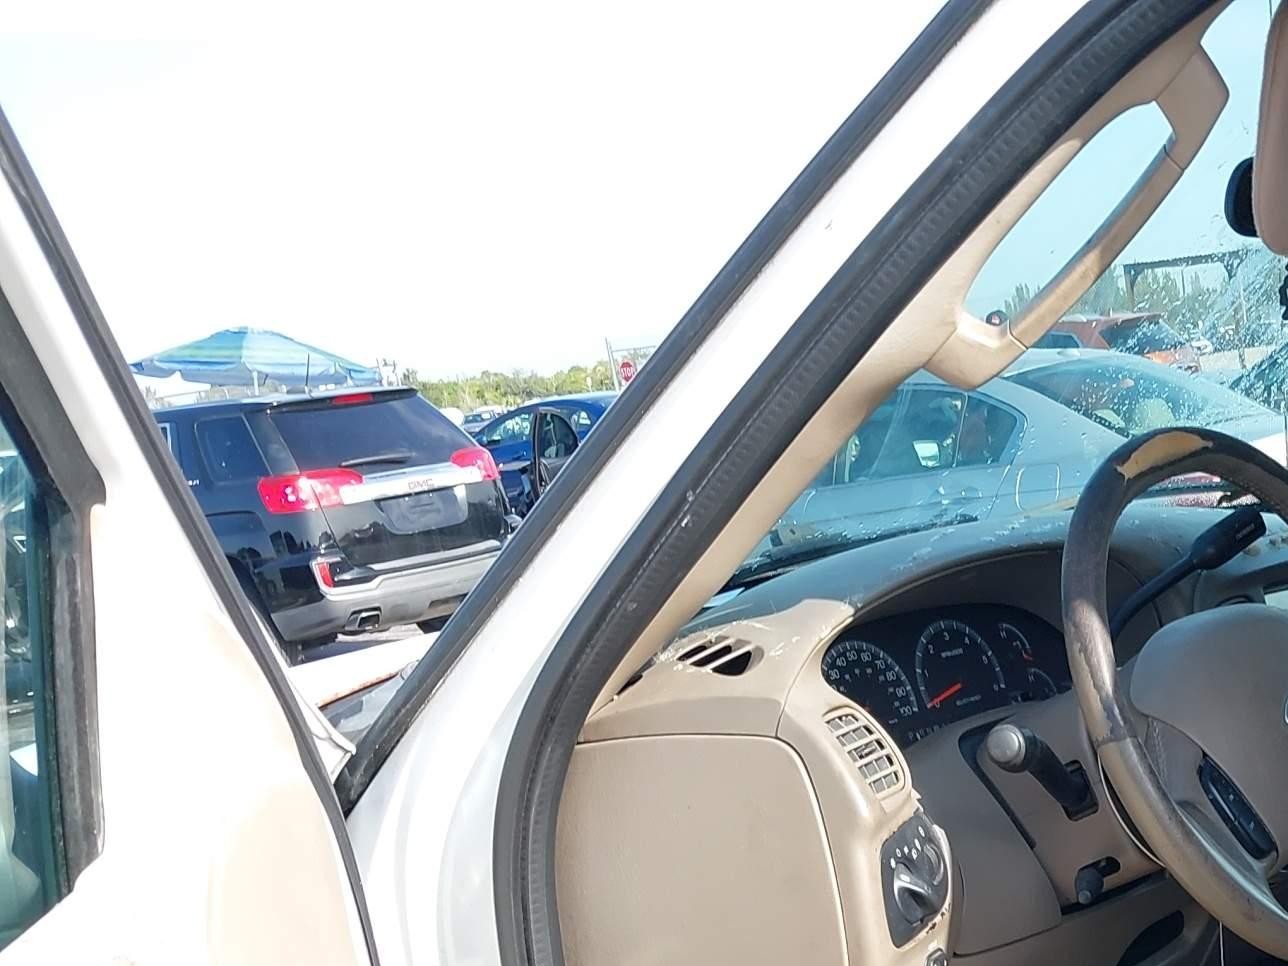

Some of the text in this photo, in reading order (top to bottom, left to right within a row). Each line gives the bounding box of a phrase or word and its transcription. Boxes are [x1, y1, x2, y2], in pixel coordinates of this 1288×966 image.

[928, 644, 934, 654] 2
[846, 650, 857, 661] 50
[860, 652, 872, 662] 60
[836, 657, 847, 667] 40
[875, 660, 886, 670] 70
[829, 669, 840, 680] 30
[886, 670, 897, 681] 80
